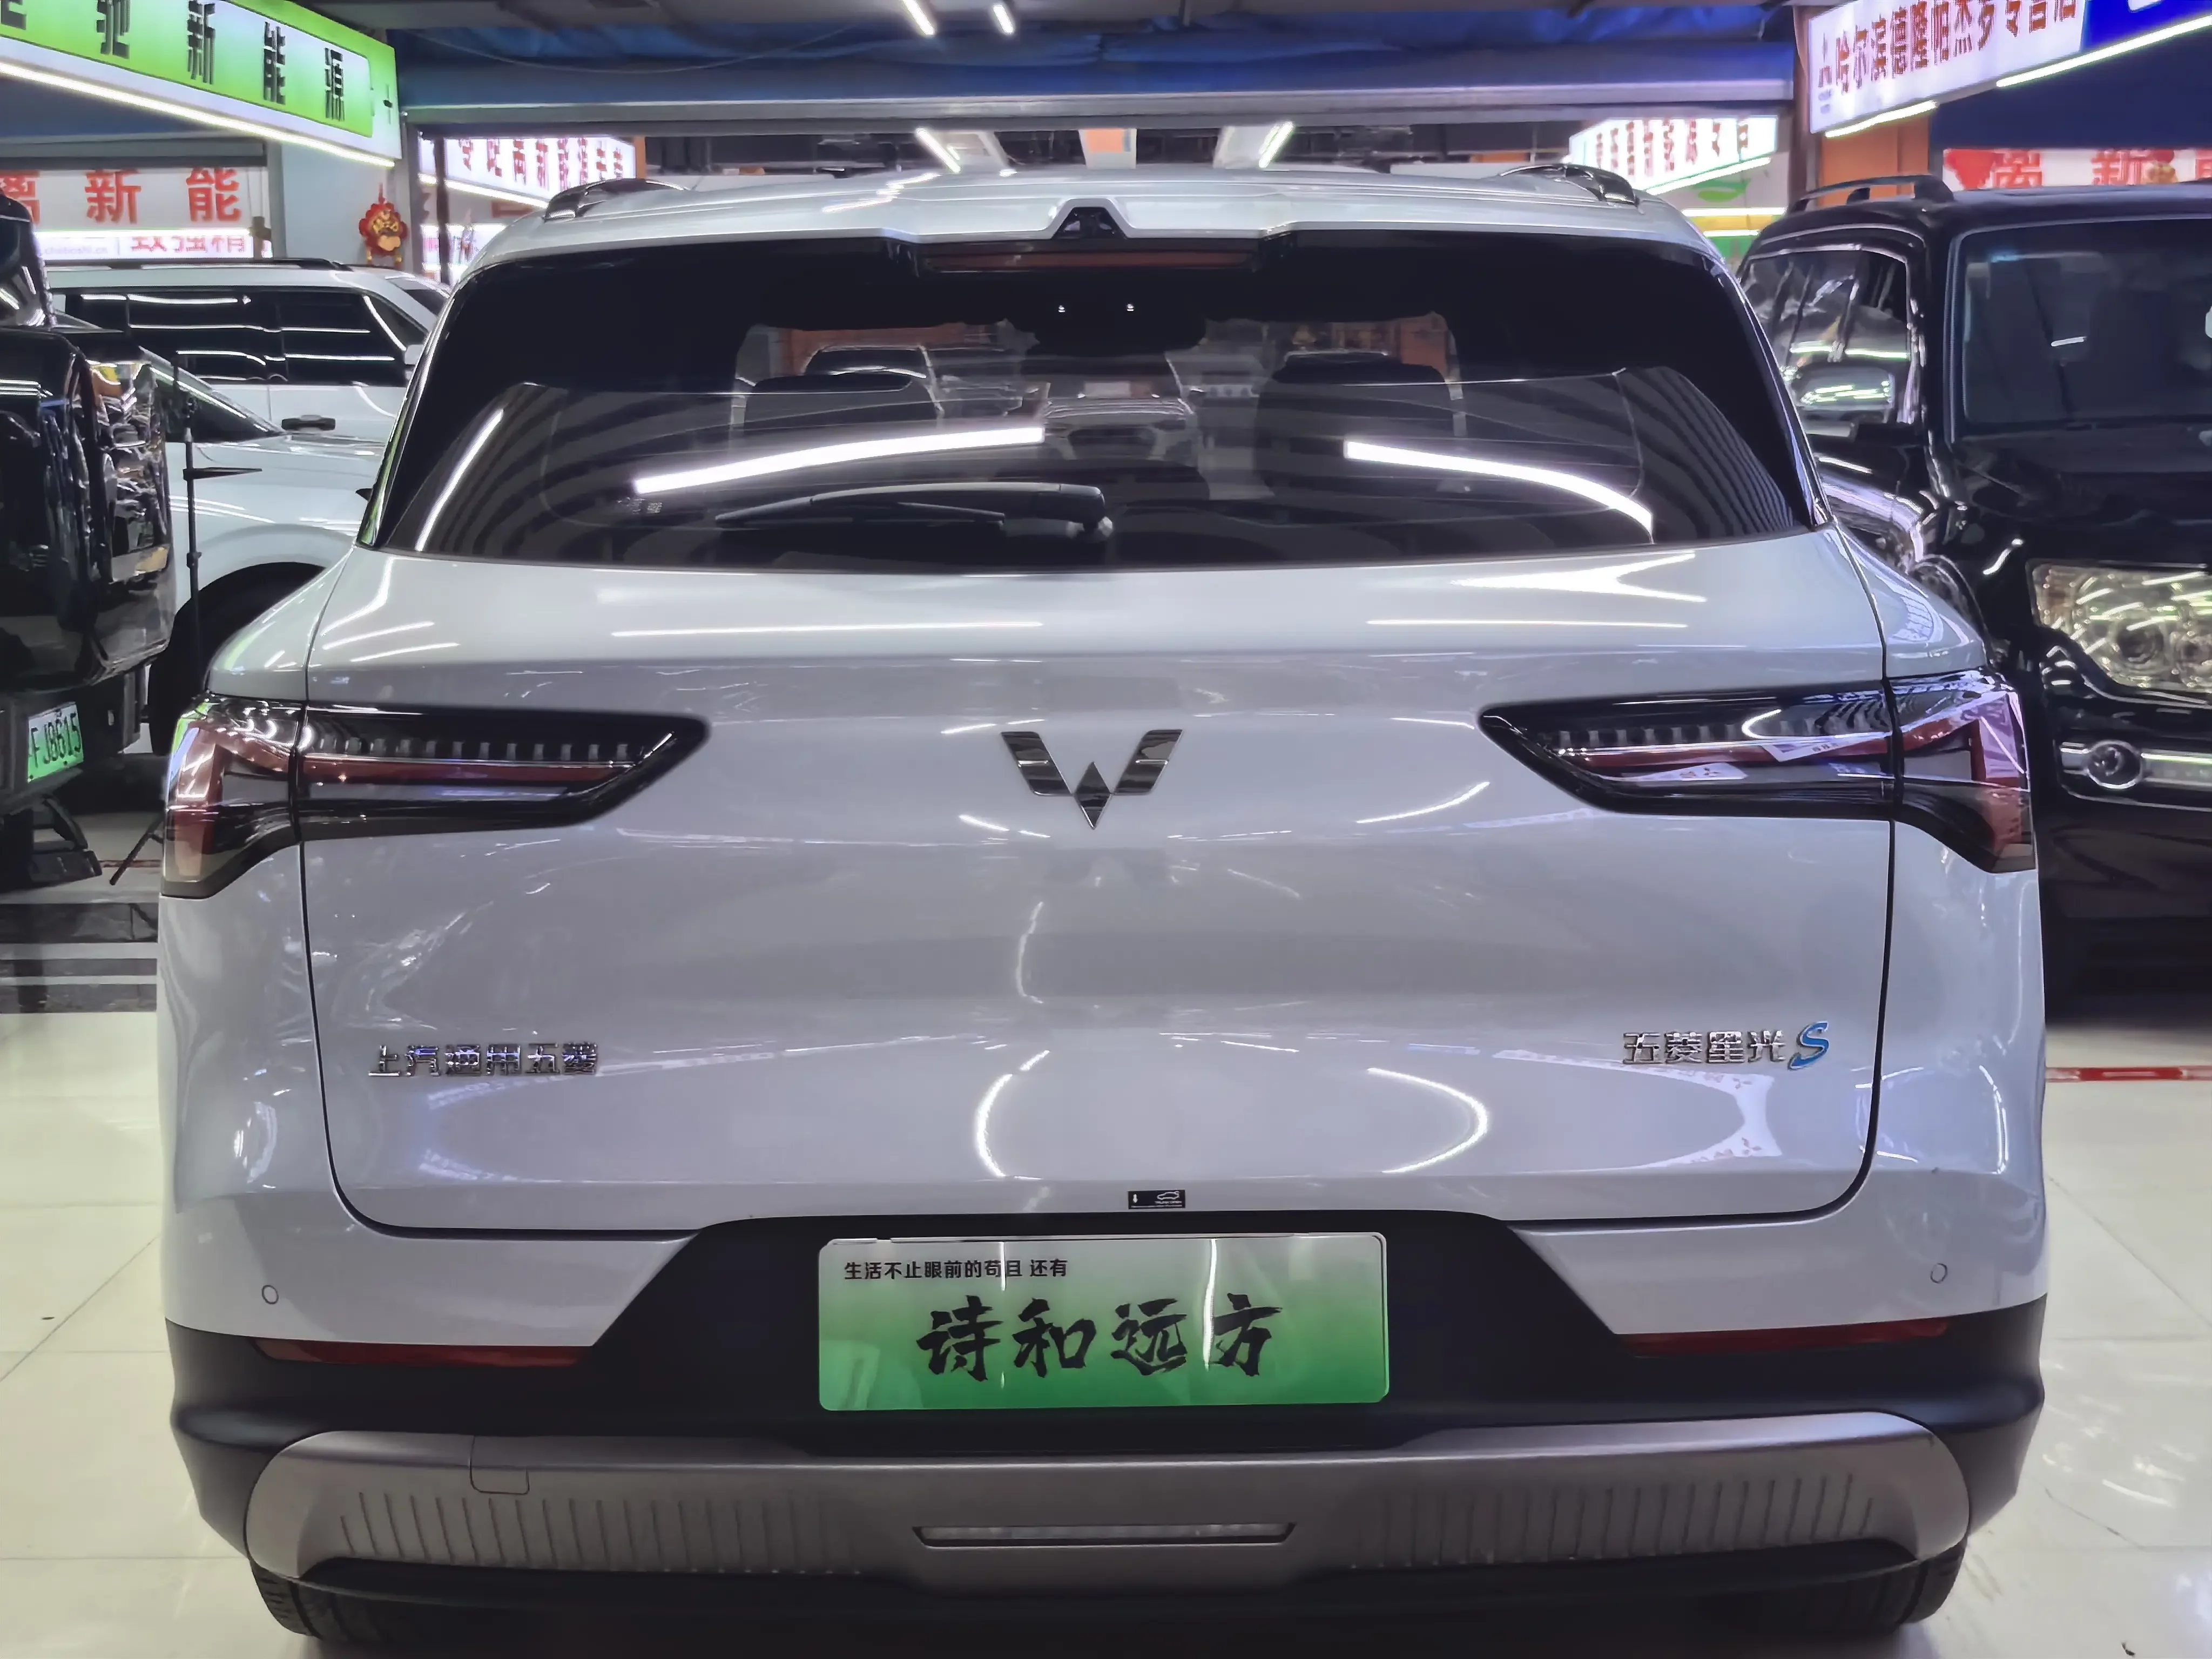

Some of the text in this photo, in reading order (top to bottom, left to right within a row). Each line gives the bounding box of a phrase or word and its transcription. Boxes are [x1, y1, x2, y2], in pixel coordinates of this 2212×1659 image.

[0, 0, 346, 122] 驰新能源
[1836, 0, 2076, 94] 哈尔滨德隆帕杰罗
[367, 1042, 598, 1076] 上汽通用五菱
[844, 1259, 1068, 1280] 生活不止眼前的苟且 还有
[915, 1293, 1283, 1382] 诗和远方
